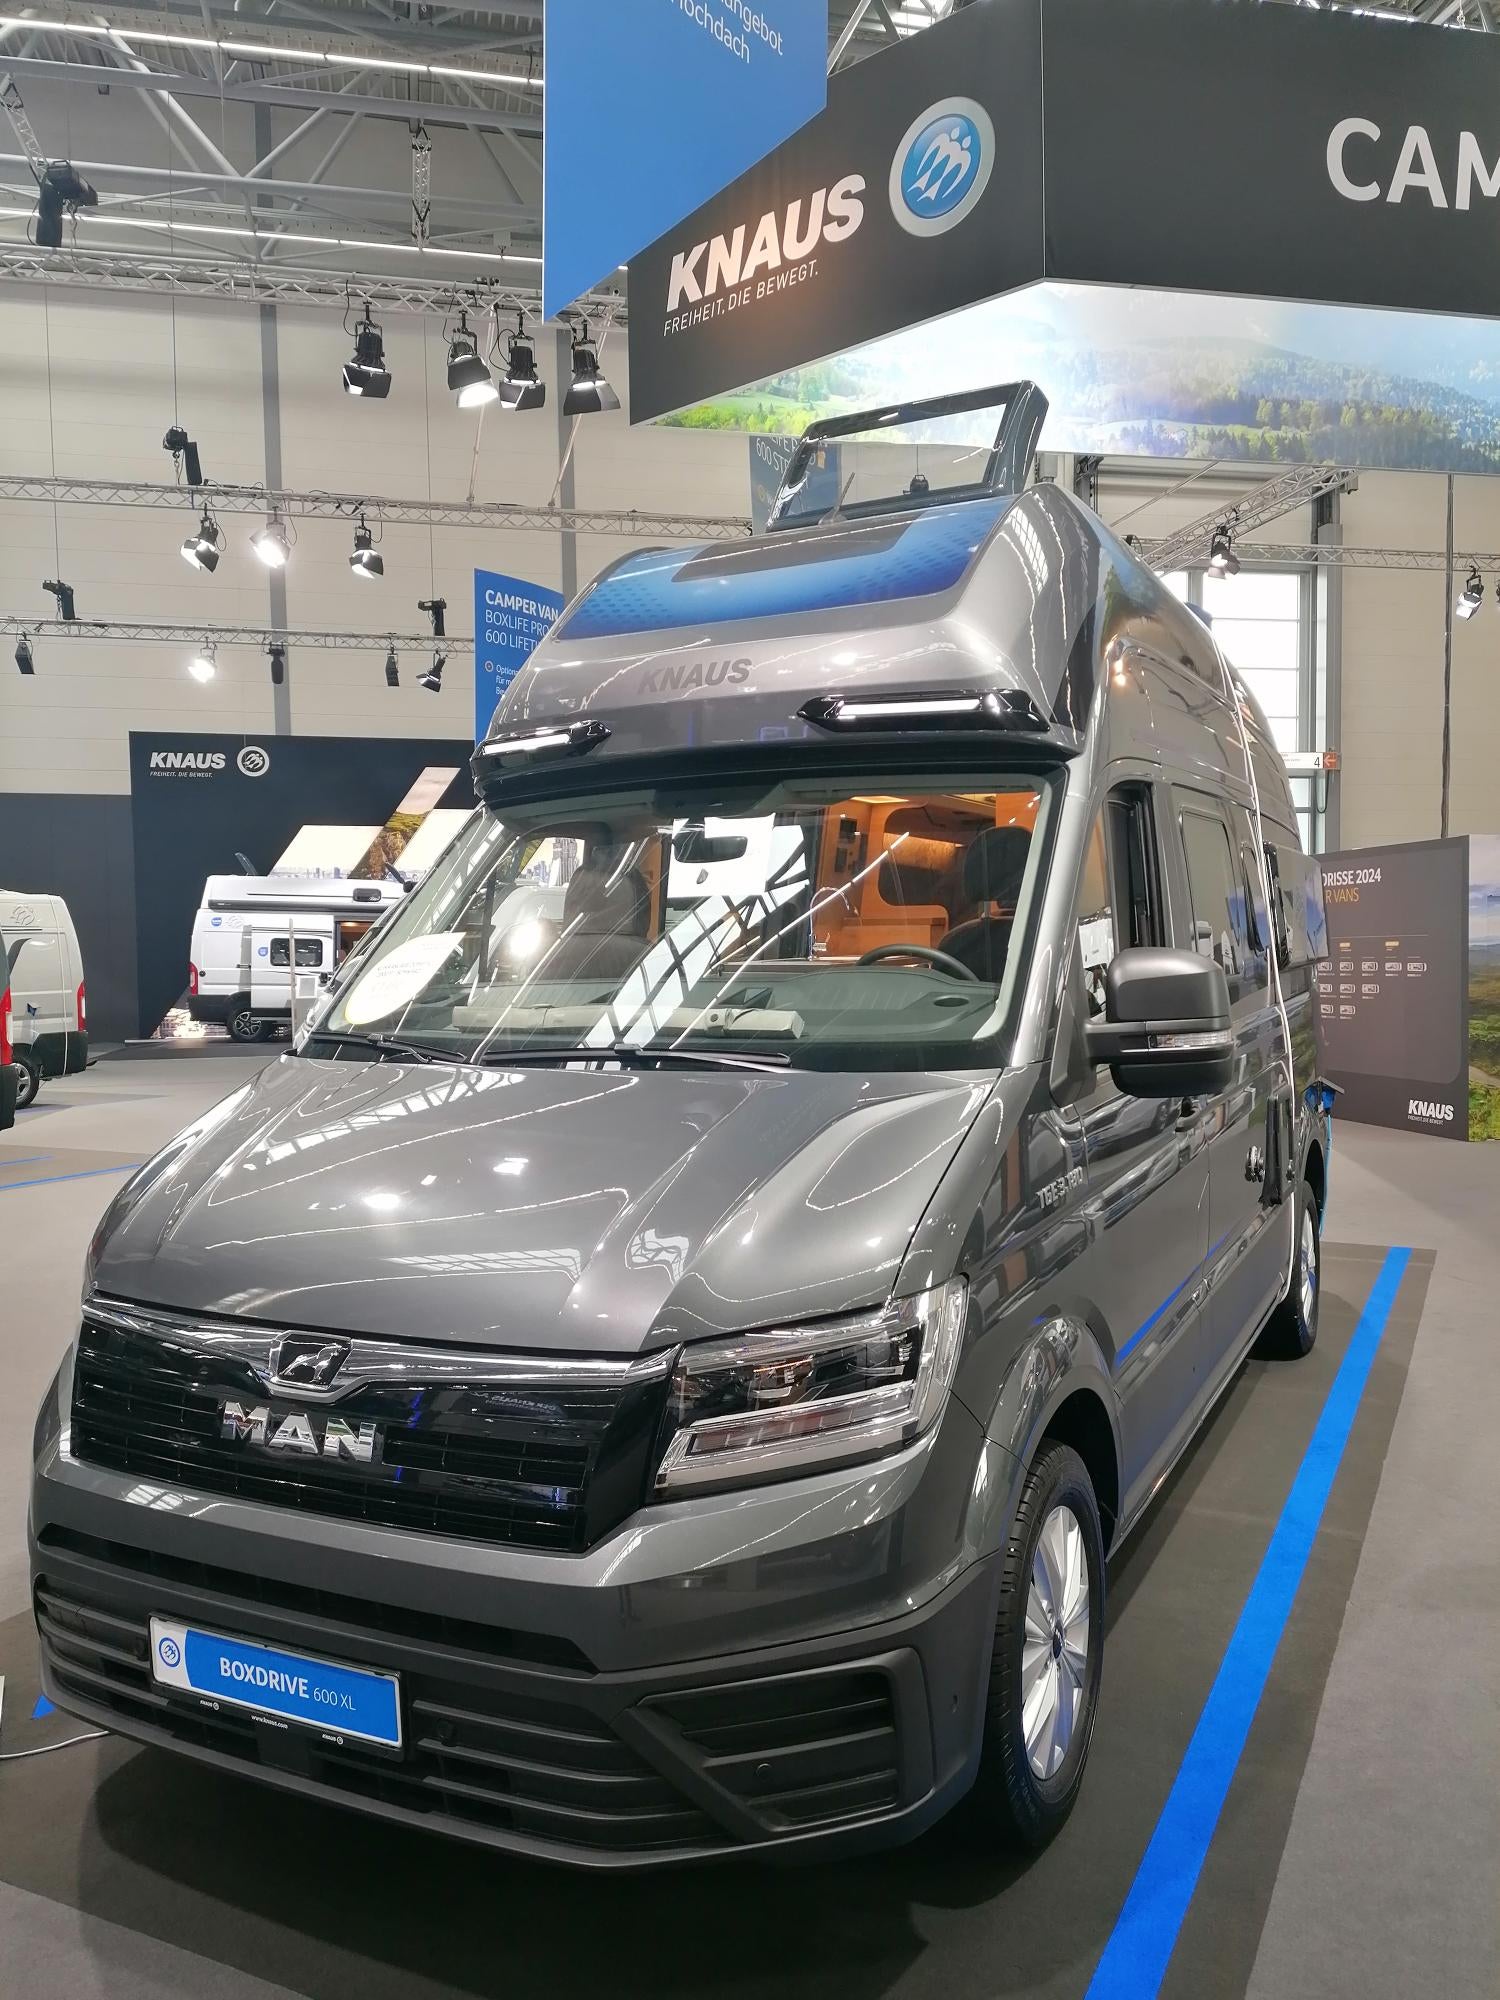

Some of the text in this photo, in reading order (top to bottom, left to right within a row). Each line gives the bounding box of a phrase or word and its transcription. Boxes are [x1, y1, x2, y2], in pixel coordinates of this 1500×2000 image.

[720, 0, 783, 56] angebot
[666, 174, 867, 313] KNAUS
[728, 285, 753, 311] DIE
[756, 258, 819, 299] BEWEGT.
[756, 437, 772, 465] 600
[485, 589, 537, 617] CAMPER
[485, 609, 530, 633] BOXLIFE
[485, 629, 507, 647] 600
[637, 658, 753, 695] KNAUS
[149, 751, 226, 769] KNAUS
[1313, 756, 1321, 768] 4
[1355, 867, 1382, 884] 2024
[1333, 887, 1360, 904] VANS
[1408, 1099, 1454, 1121] KNAUS
[220, 1400, 379, 1463] MAN
[219, 1657, 357, 1711] BOXDRIVE 600 XL
